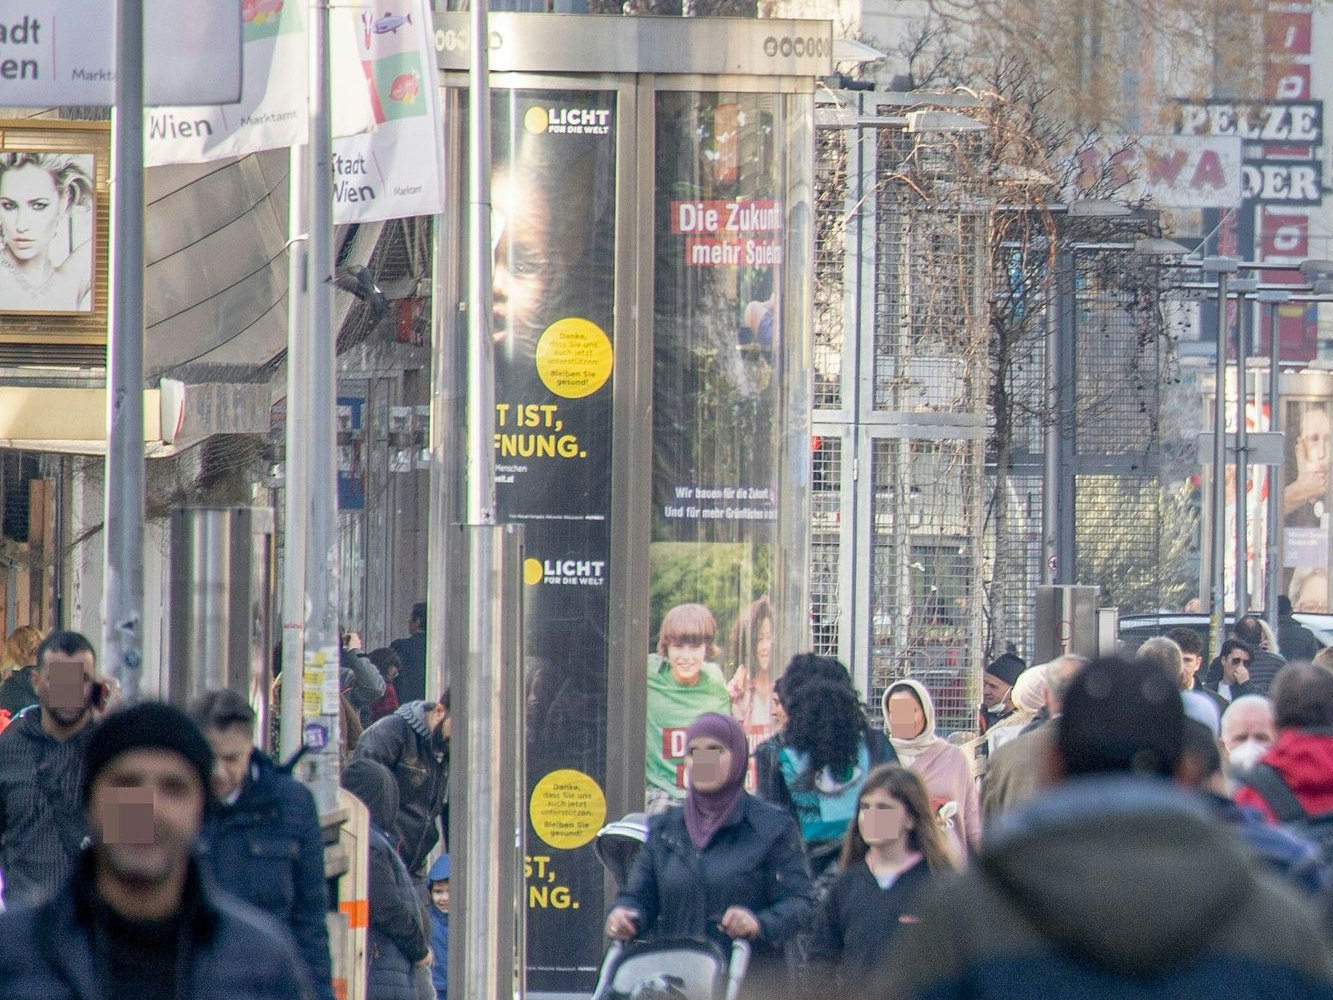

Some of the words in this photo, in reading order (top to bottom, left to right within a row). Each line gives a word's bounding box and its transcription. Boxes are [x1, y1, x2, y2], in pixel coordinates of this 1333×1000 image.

[71, 68, 117, 82] Markt
[240, 110, 298, 127] Marktamt
[548, 108, 609, 126] LICHT
[149, 114, 213, 139] Wien
[584, 126, 609, 134] WELT
[679, 204, 718, 231] Die
[692, 242, 740, 265] mehr
[517, 404, 562, 431] IST,
[675, 487, 693, 498] Wir
[664, 506, 684, 518] Und
[686, 507, 699, 518] für
[702, 508, 723, 518] mehr
[544, 560, 605, 576] LICHT
[580, 577, 604, 585] WELT
[553, 784, 581, 792] Danke,
[544, 821, 574, 829] Bleiben
[577, 821, 590, 829] Sie
[550, 830, 583, 838] gesund!
[530, 887, 580, 910] NG.
